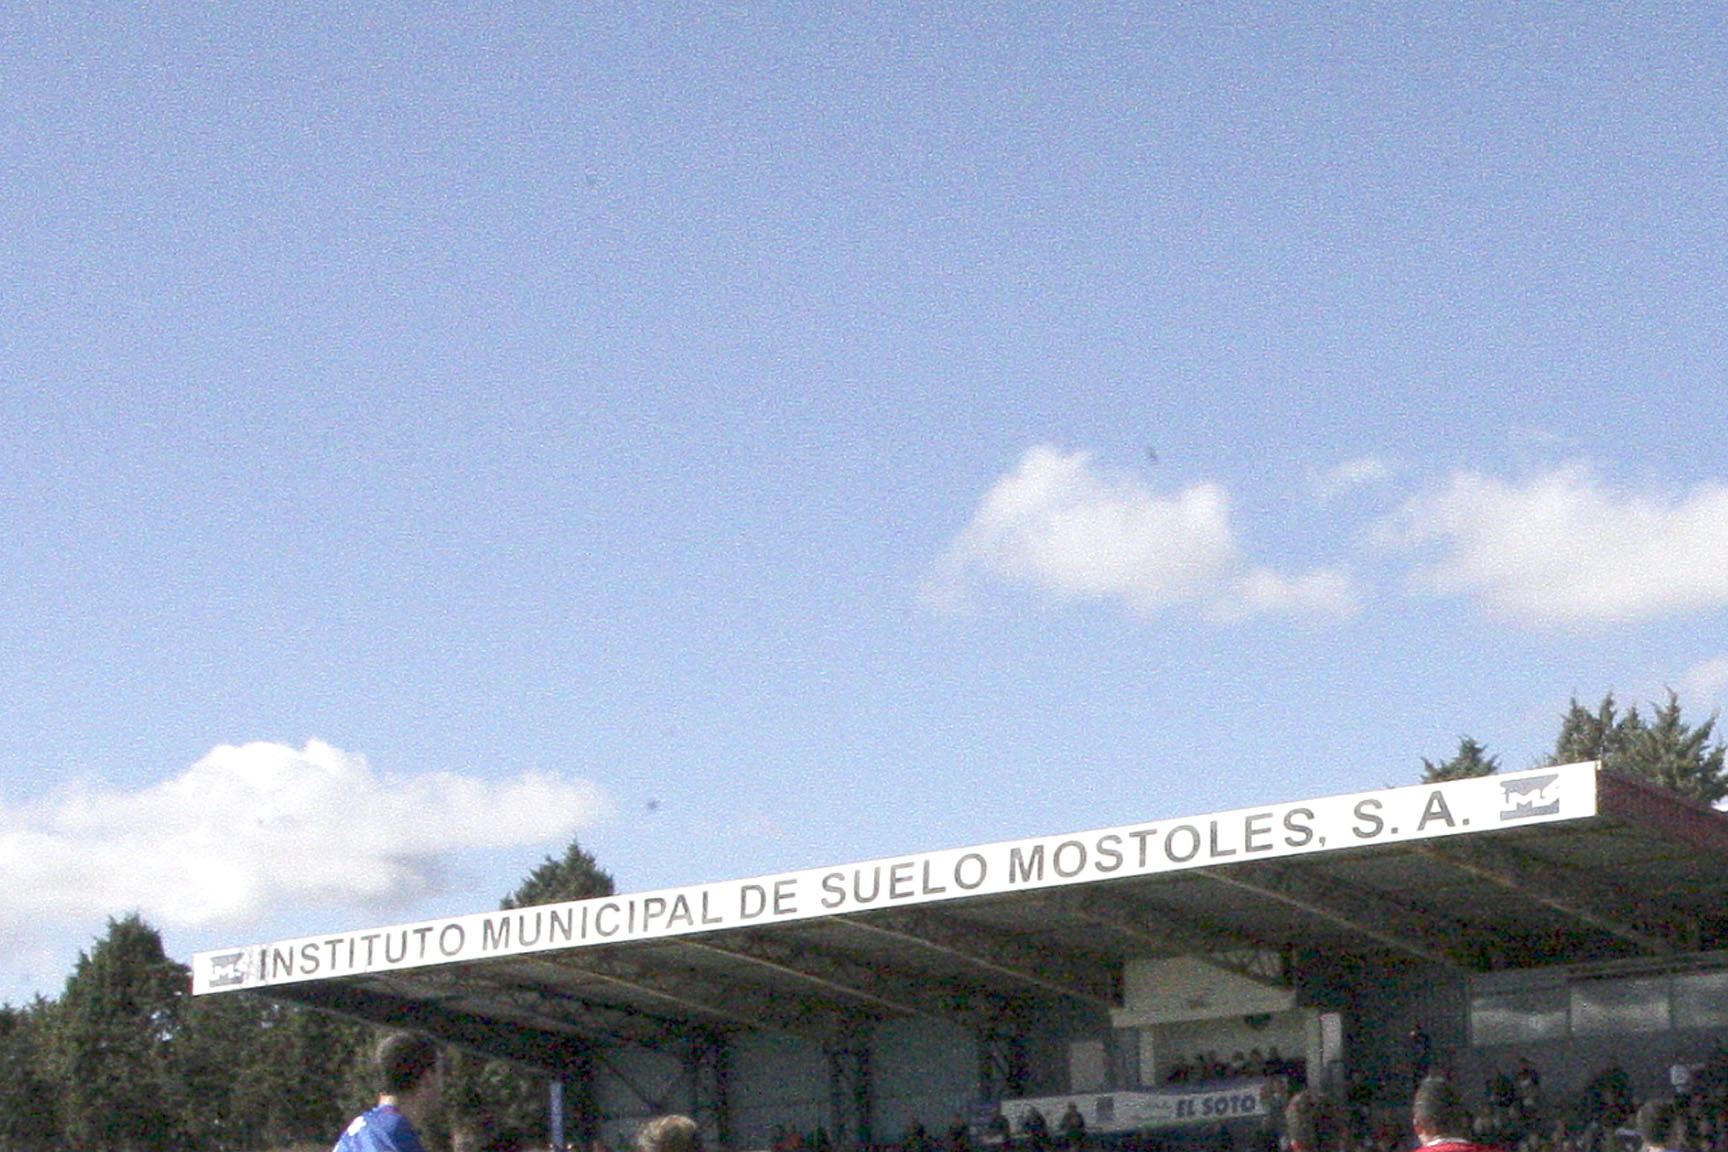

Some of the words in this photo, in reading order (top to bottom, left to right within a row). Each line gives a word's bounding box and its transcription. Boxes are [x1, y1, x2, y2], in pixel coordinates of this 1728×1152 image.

[259, 923, 465, 981] INSTITUTO
[482, 890, 723, 951] MUNICIPAL
[740, 879, 798, 918] DE
[820, 852, 988, 909] SUELO
[1008, 806, 1326, 886] MOSTOLES,
[1175, 1098, 1196, 1118] EL
[1202, 1095, 1257, 1116] SOTO
